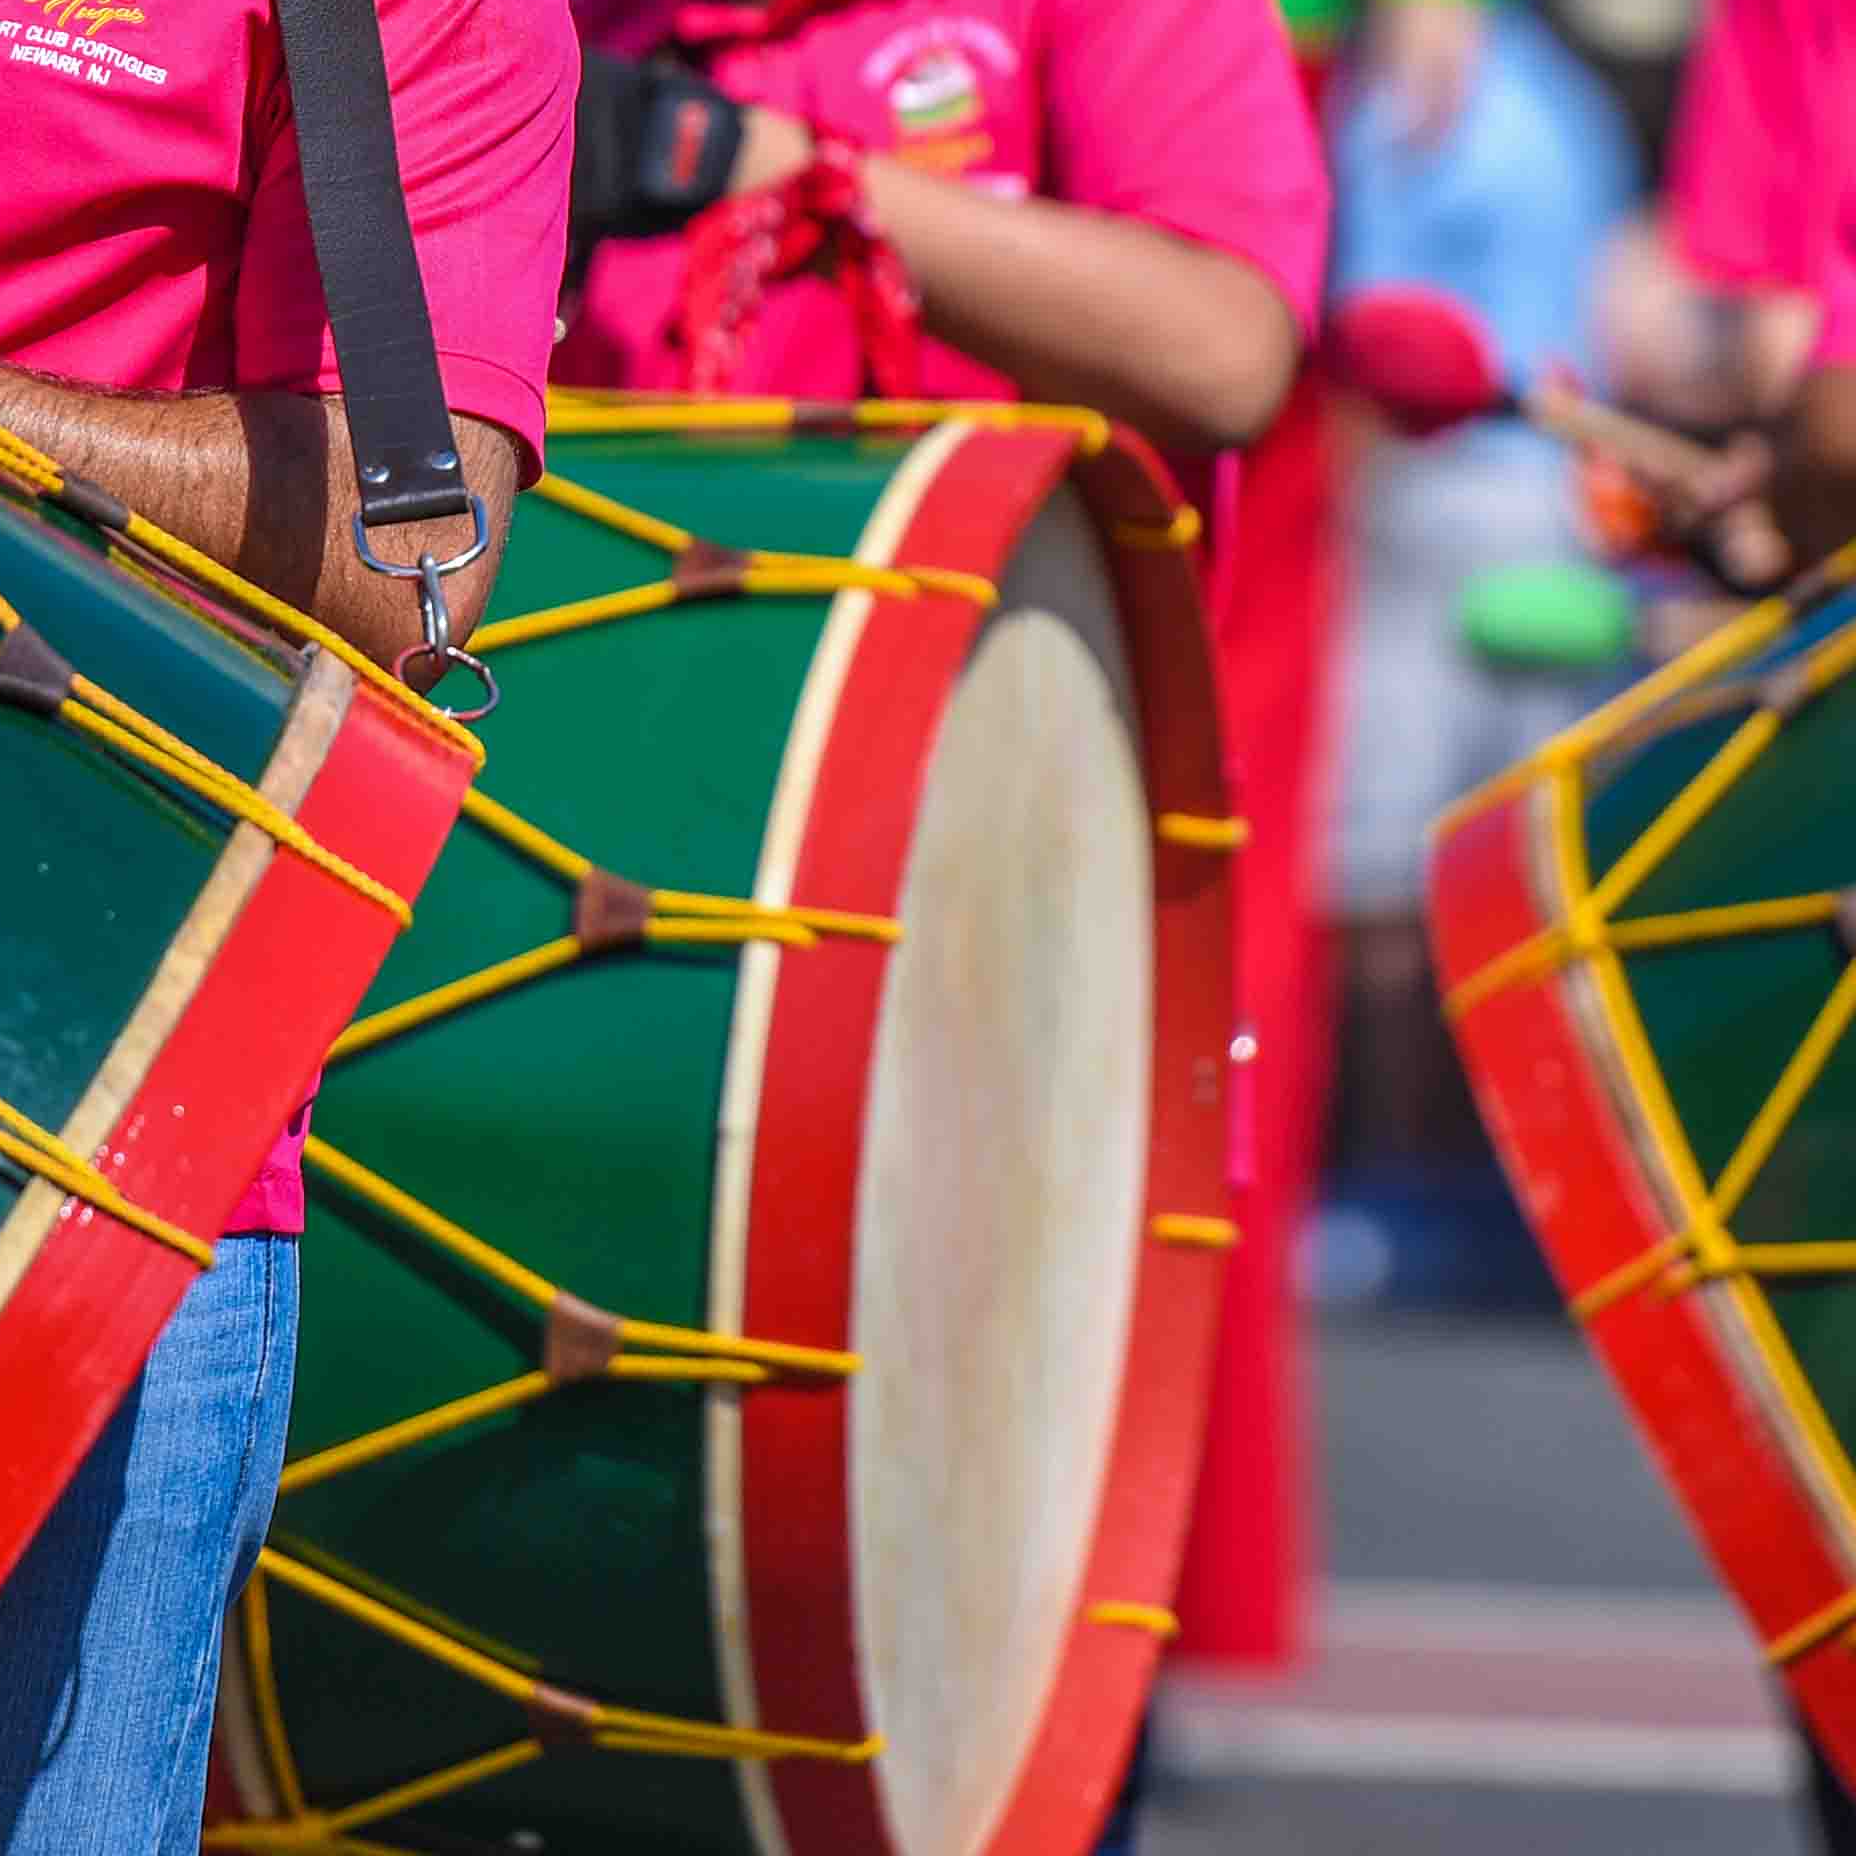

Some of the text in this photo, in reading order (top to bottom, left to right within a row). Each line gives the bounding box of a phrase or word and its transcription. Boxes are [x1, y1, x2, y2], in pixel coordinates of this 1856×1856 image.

[10, 43, 112, 85] NEWARK NJ
[25, 24, 70, 47] CLUB
[72, 36, 168, 84] PORTUGUES
